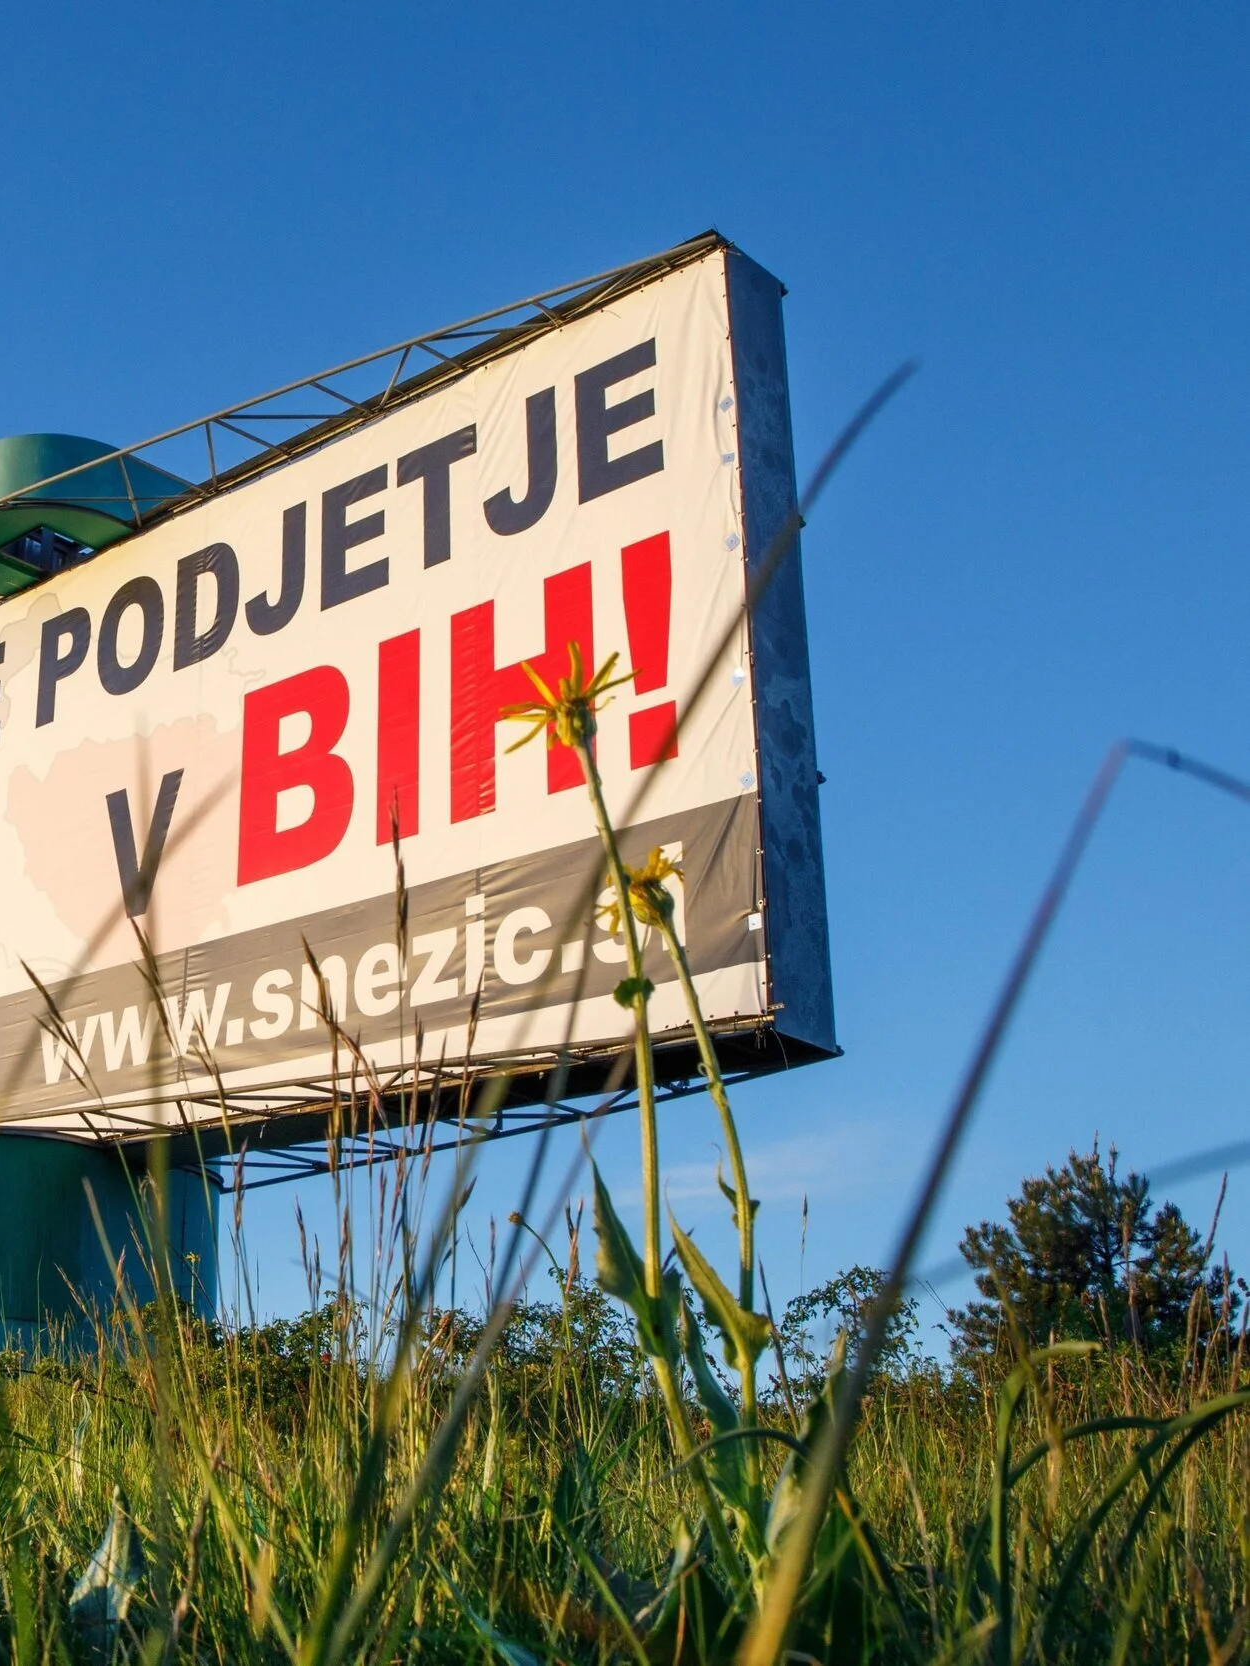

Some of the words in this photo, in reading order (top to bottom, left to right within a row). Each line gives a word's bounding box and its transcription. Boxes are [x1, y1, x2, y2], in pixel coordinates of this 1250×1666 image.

[35, 337, 664, 728] PODJETJE
[106, 769, 184, 919] V
[237, 530, 678, 887] BIH!
